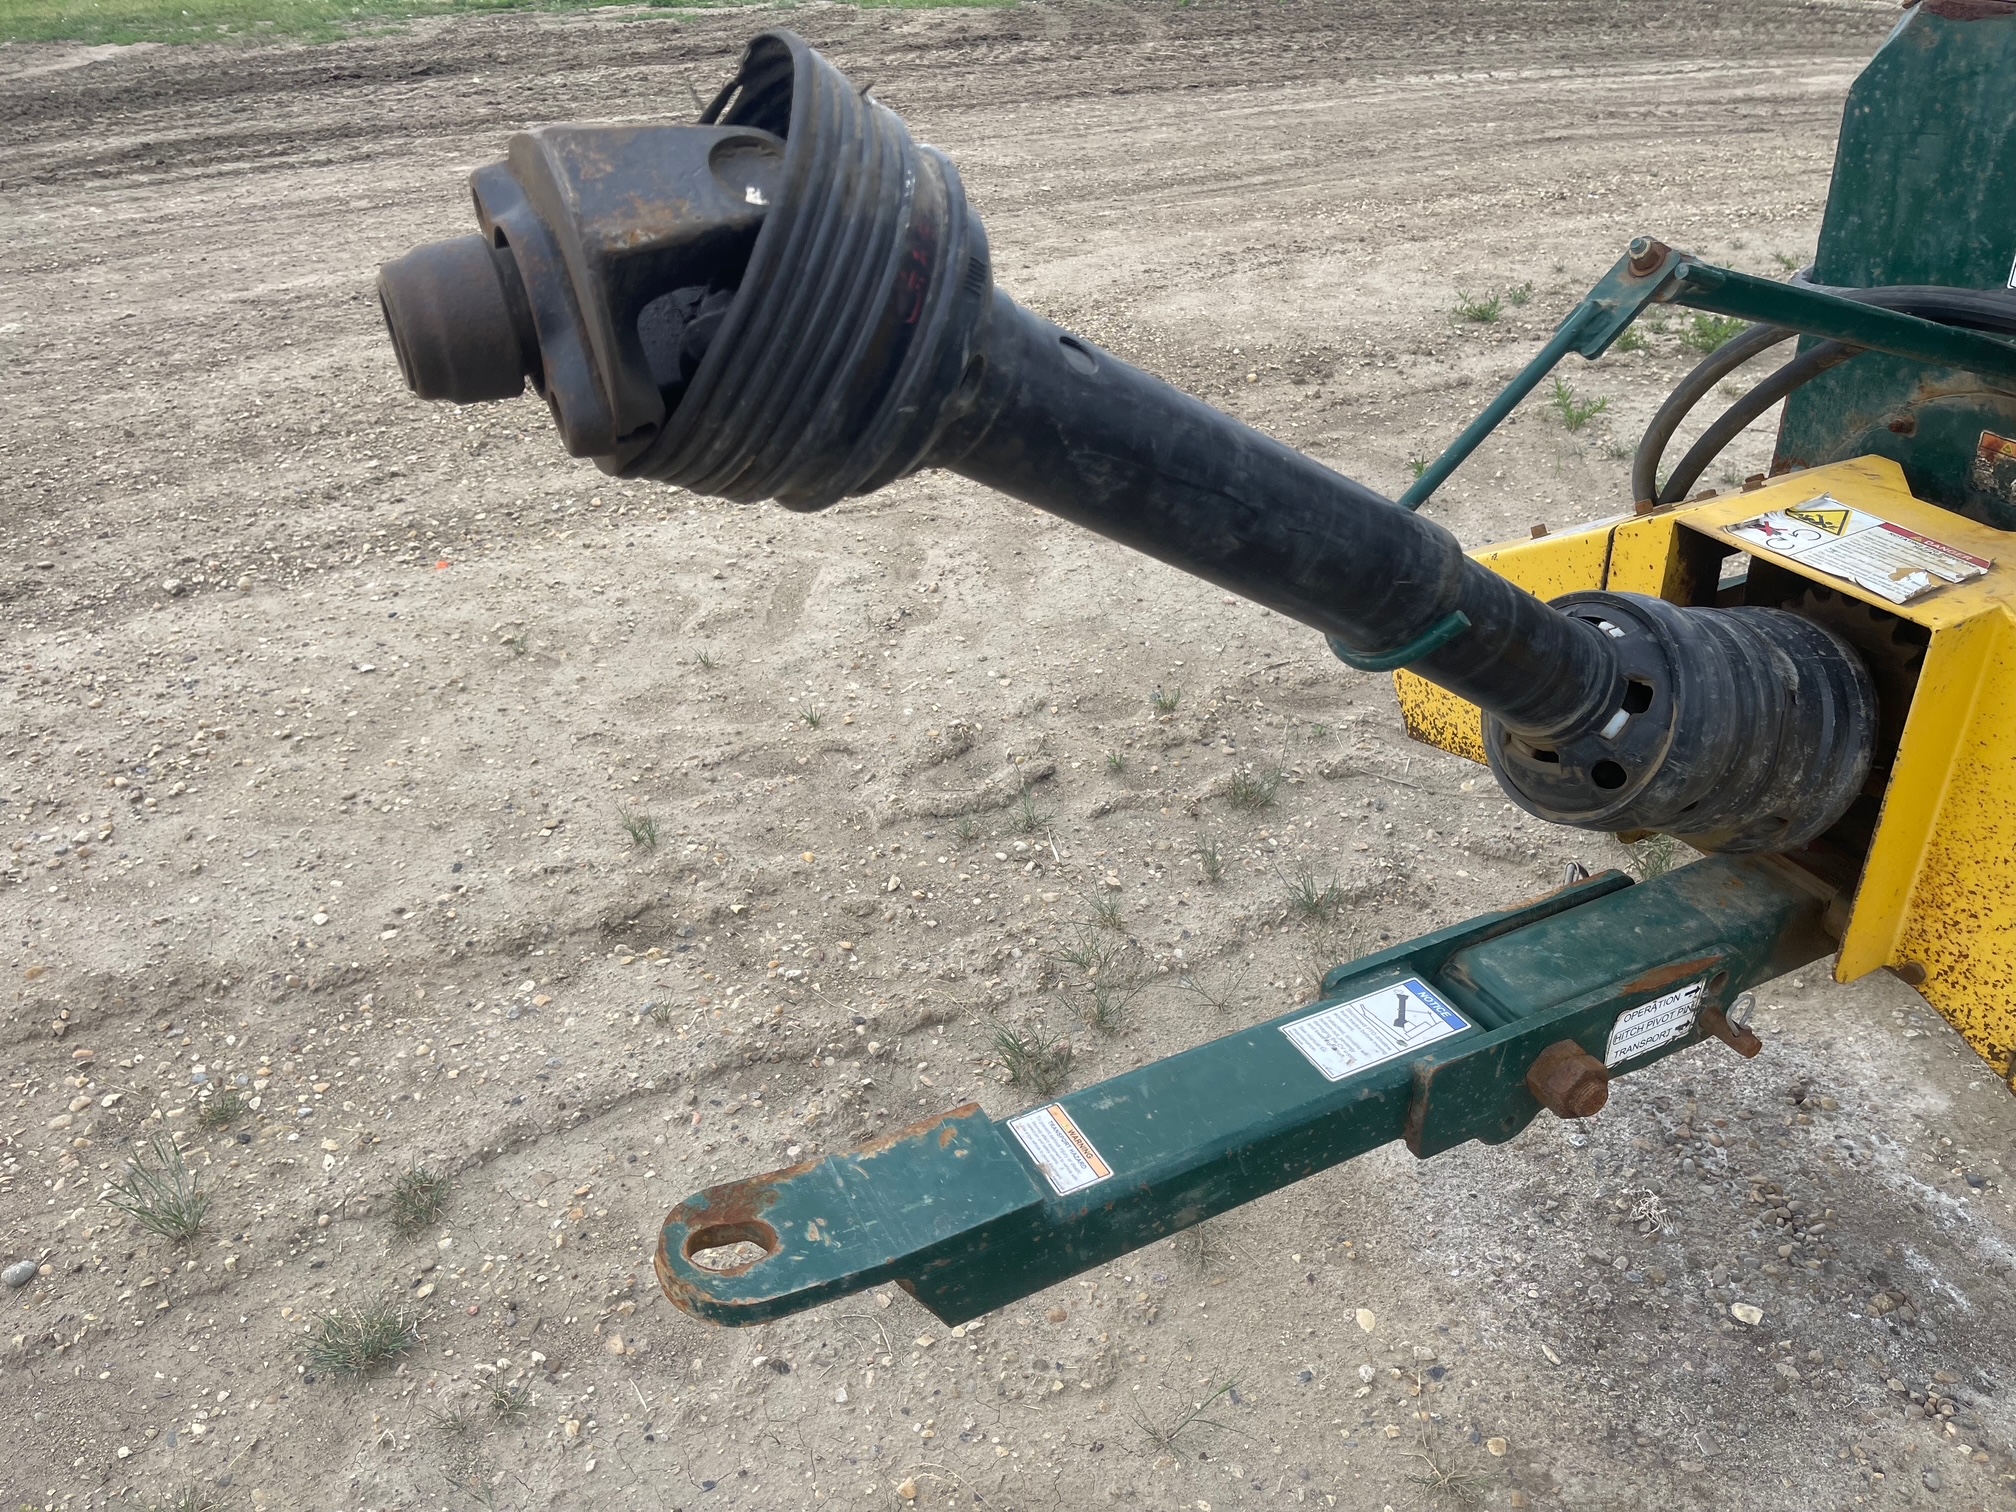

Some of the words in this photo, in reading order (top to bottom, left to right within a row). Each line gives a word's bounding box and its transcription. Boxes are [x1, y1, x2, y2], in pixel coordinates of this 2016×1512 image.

[1924, 540, 1973, 561] DANGER
[1418, 992, 1451, 1017] NOTICE
[1624, 993, 1680, 1023] OPERATION
[1614, 1024, 1643, 1043] HITCH
[1646, 1010, 1675, 1029] PIVOT
[1677, 1004, 1693, 1015] PIN
[1615, 1028, 1672, 1059] TRANSPORT
[1068, 1129, 1094, 1159] WARNING
